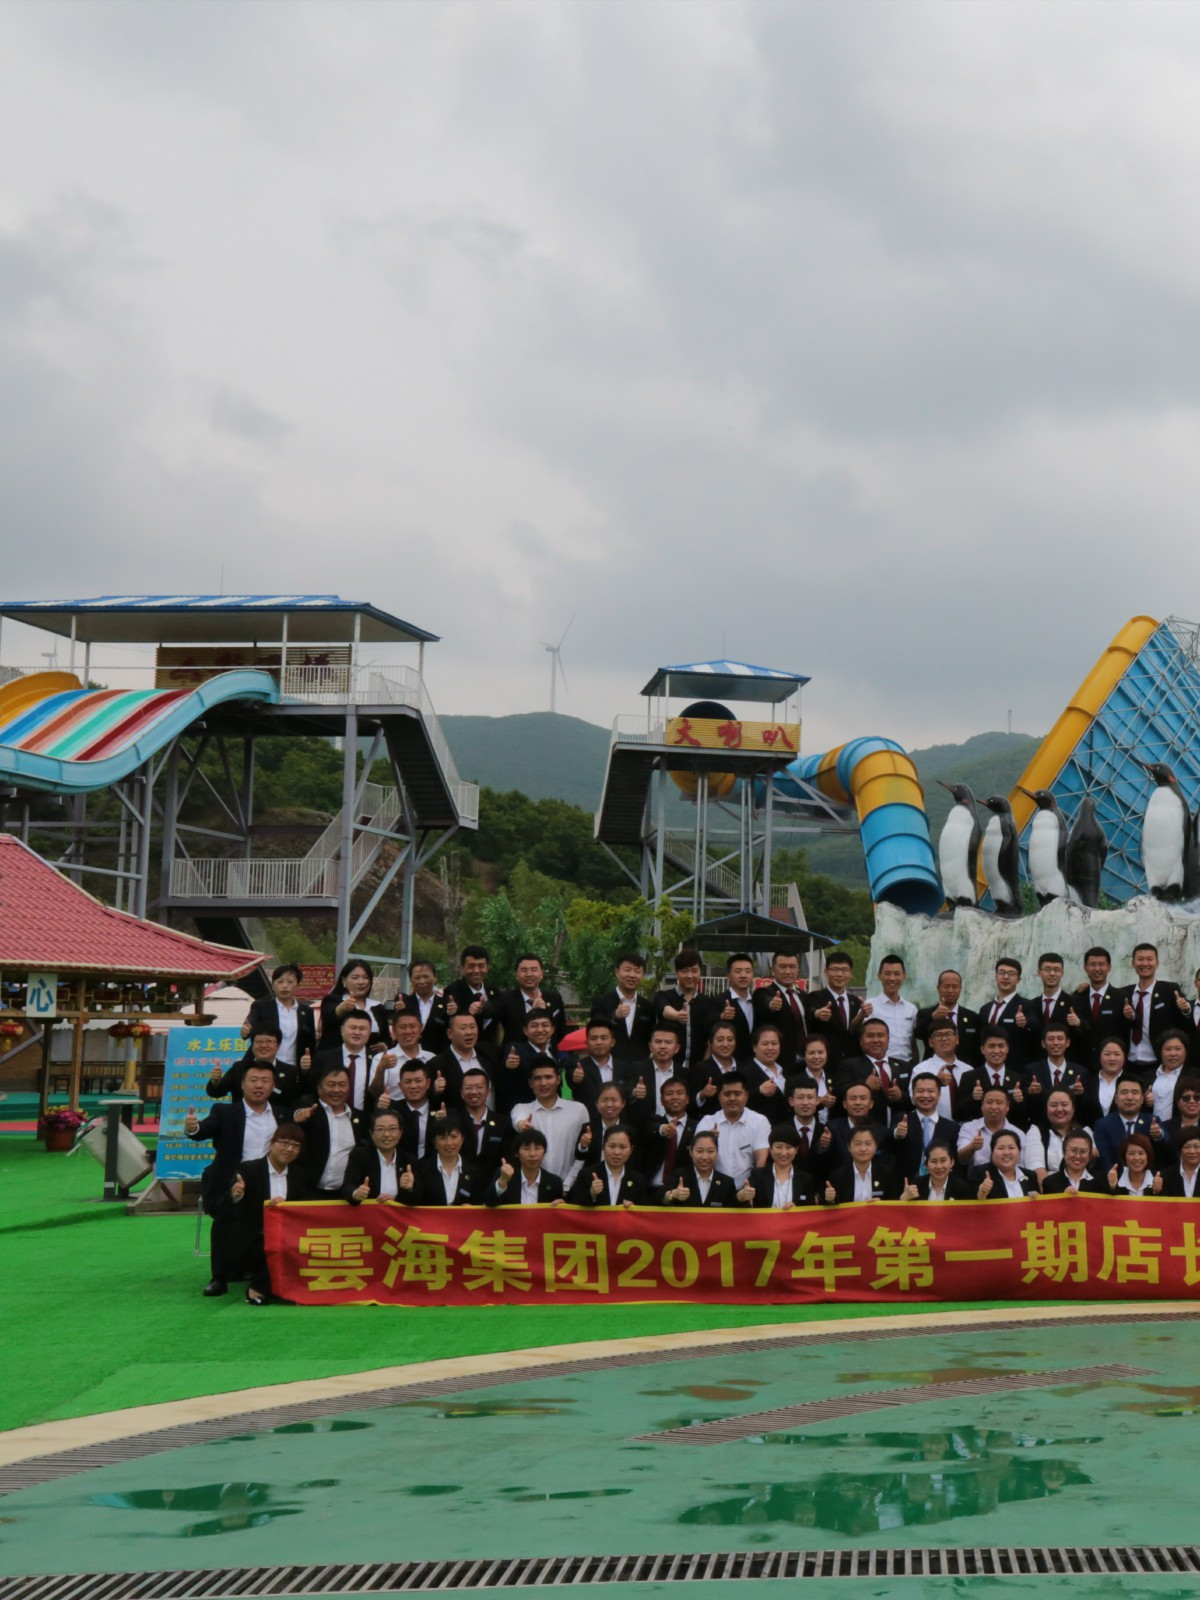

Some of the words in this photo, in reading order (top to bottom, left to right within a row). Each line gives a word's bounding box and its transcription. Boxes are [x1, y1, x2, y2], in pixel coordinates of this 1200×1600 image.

[673, 718, 794, 749] 大喇叭
[29, 978, 54, 1012] 心
